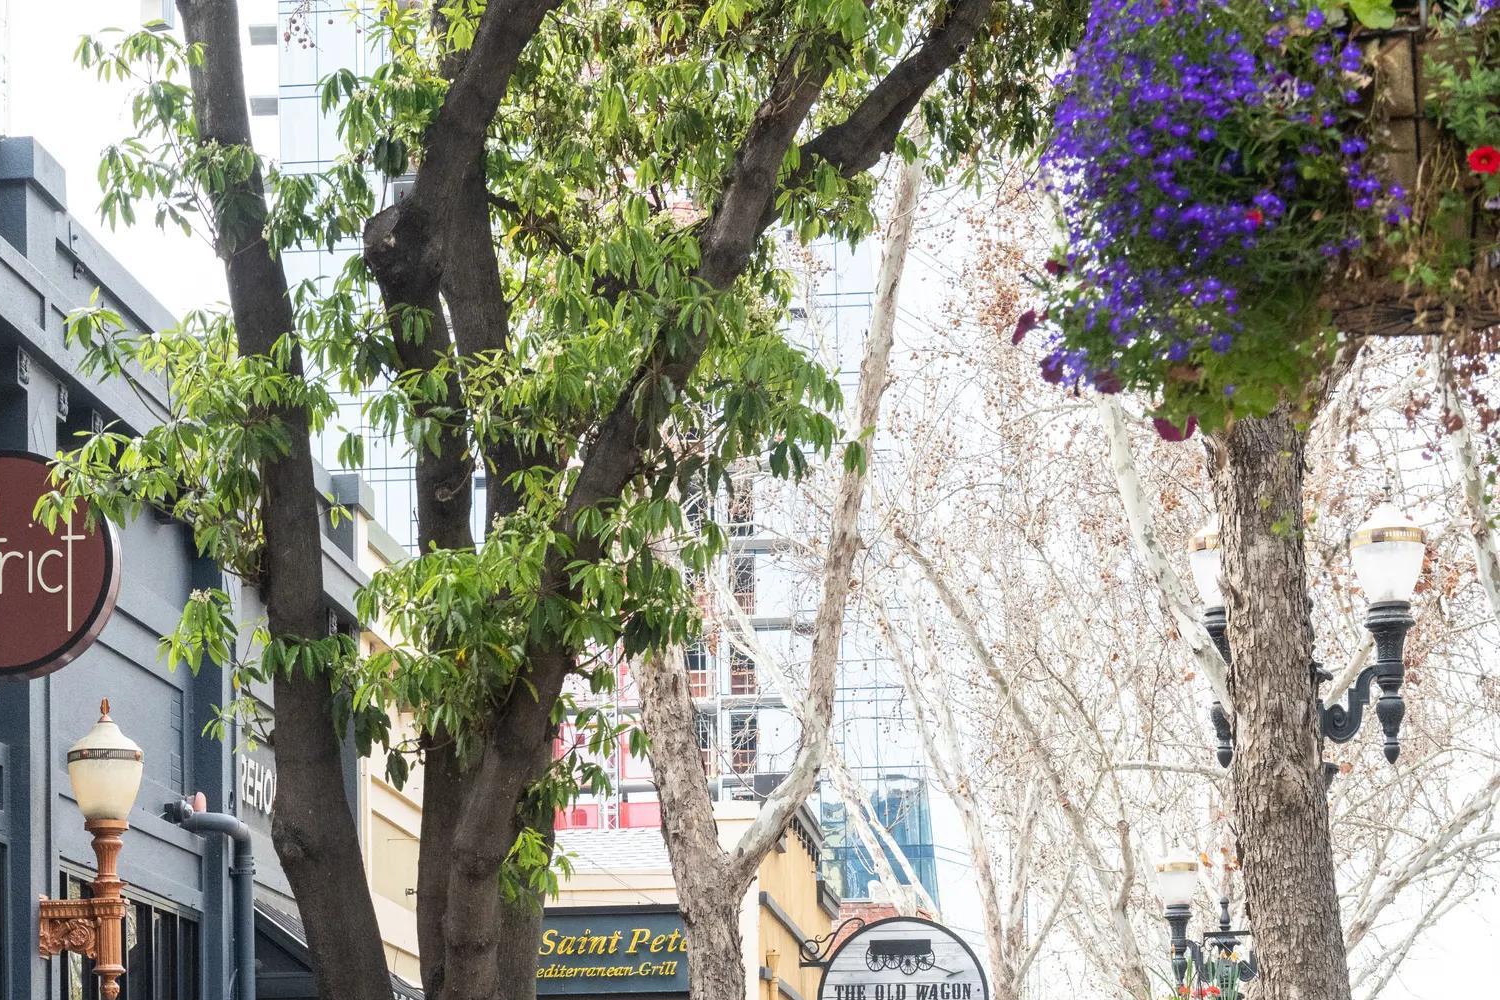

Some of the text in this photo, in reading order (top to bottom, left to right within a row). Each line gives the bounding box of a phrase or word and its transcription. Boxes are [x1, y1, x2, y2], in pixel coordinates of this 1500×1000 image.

[538, 928, 623, 956] Saint
[536, 961, 678, 978] editerranean Grill
[875, 983, 906, 1000] OLD
[916, 983, 972, 1000] WAGON
